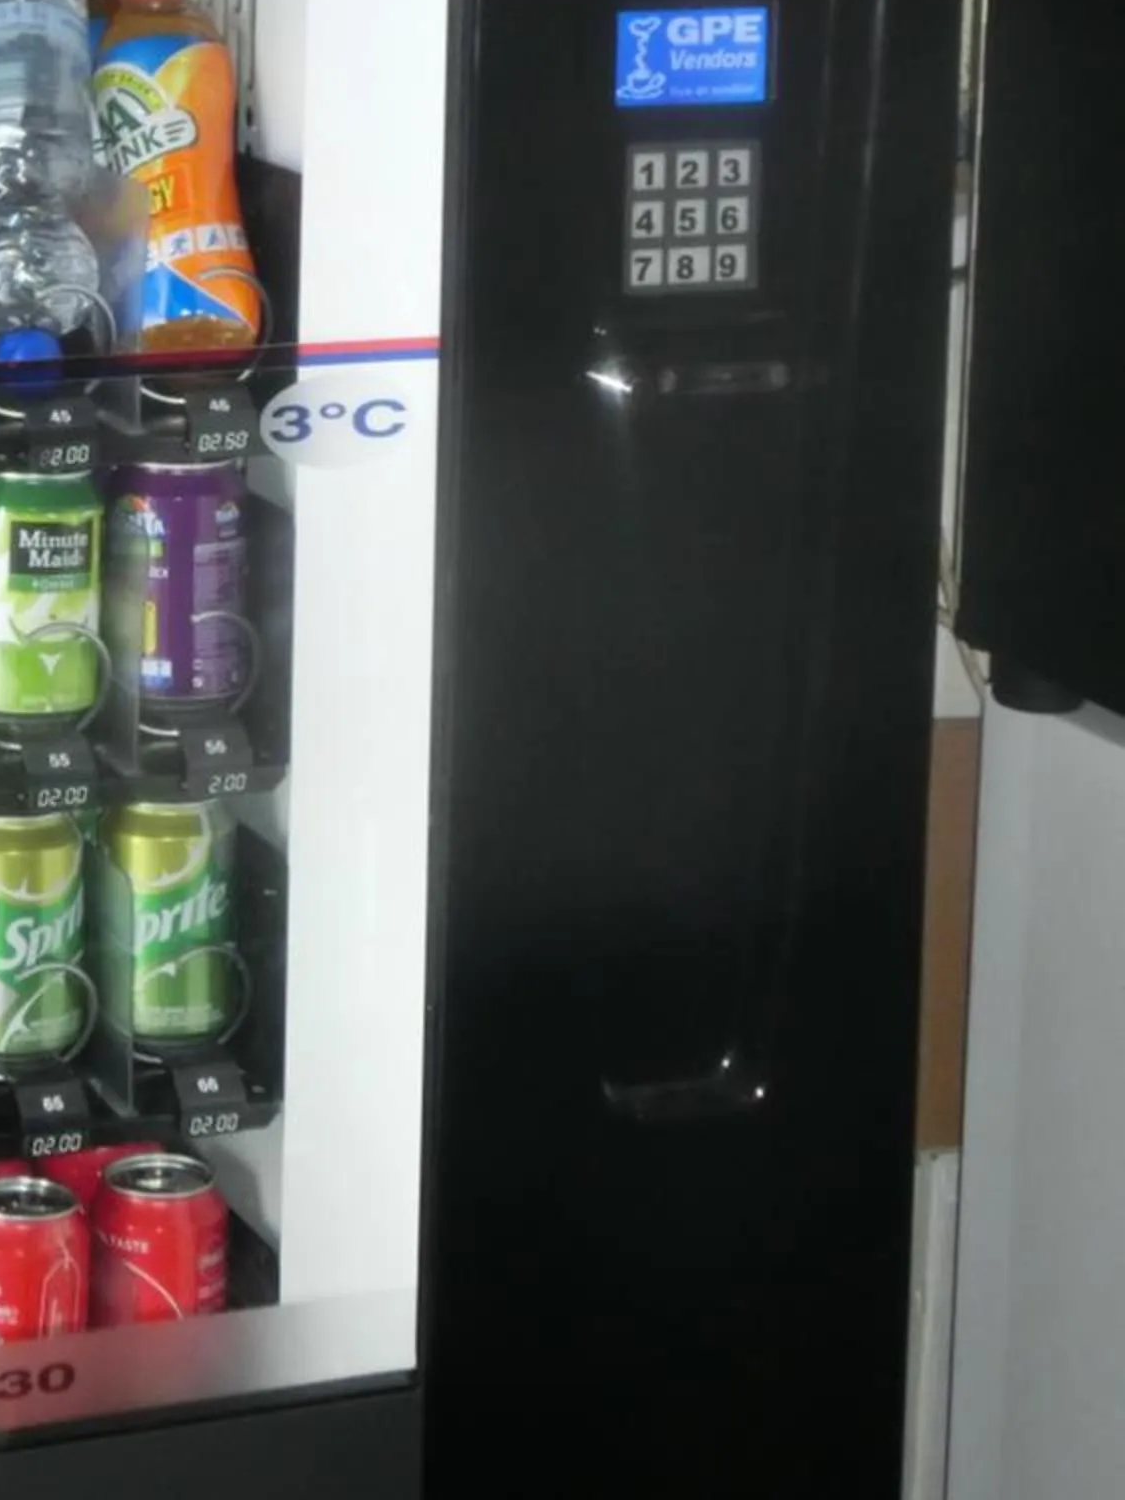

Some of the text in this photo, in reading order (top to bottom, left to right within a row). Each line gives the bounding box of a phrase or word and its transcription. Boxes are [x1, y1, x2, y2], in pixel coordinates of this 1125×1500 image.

[667, 14, 763, 45] GPE
[670, 49, 757, 71] Vendors
[640, 158, 741, 186] 1 2 3
[635, 205, 738, 235] 4 5 6
[634, 253, 737, 281] 7 8 9
[269, 398, 407, 443] 3°C
[18, 529, 88, 549] Minute
[137, 878, 228, 950] prite
